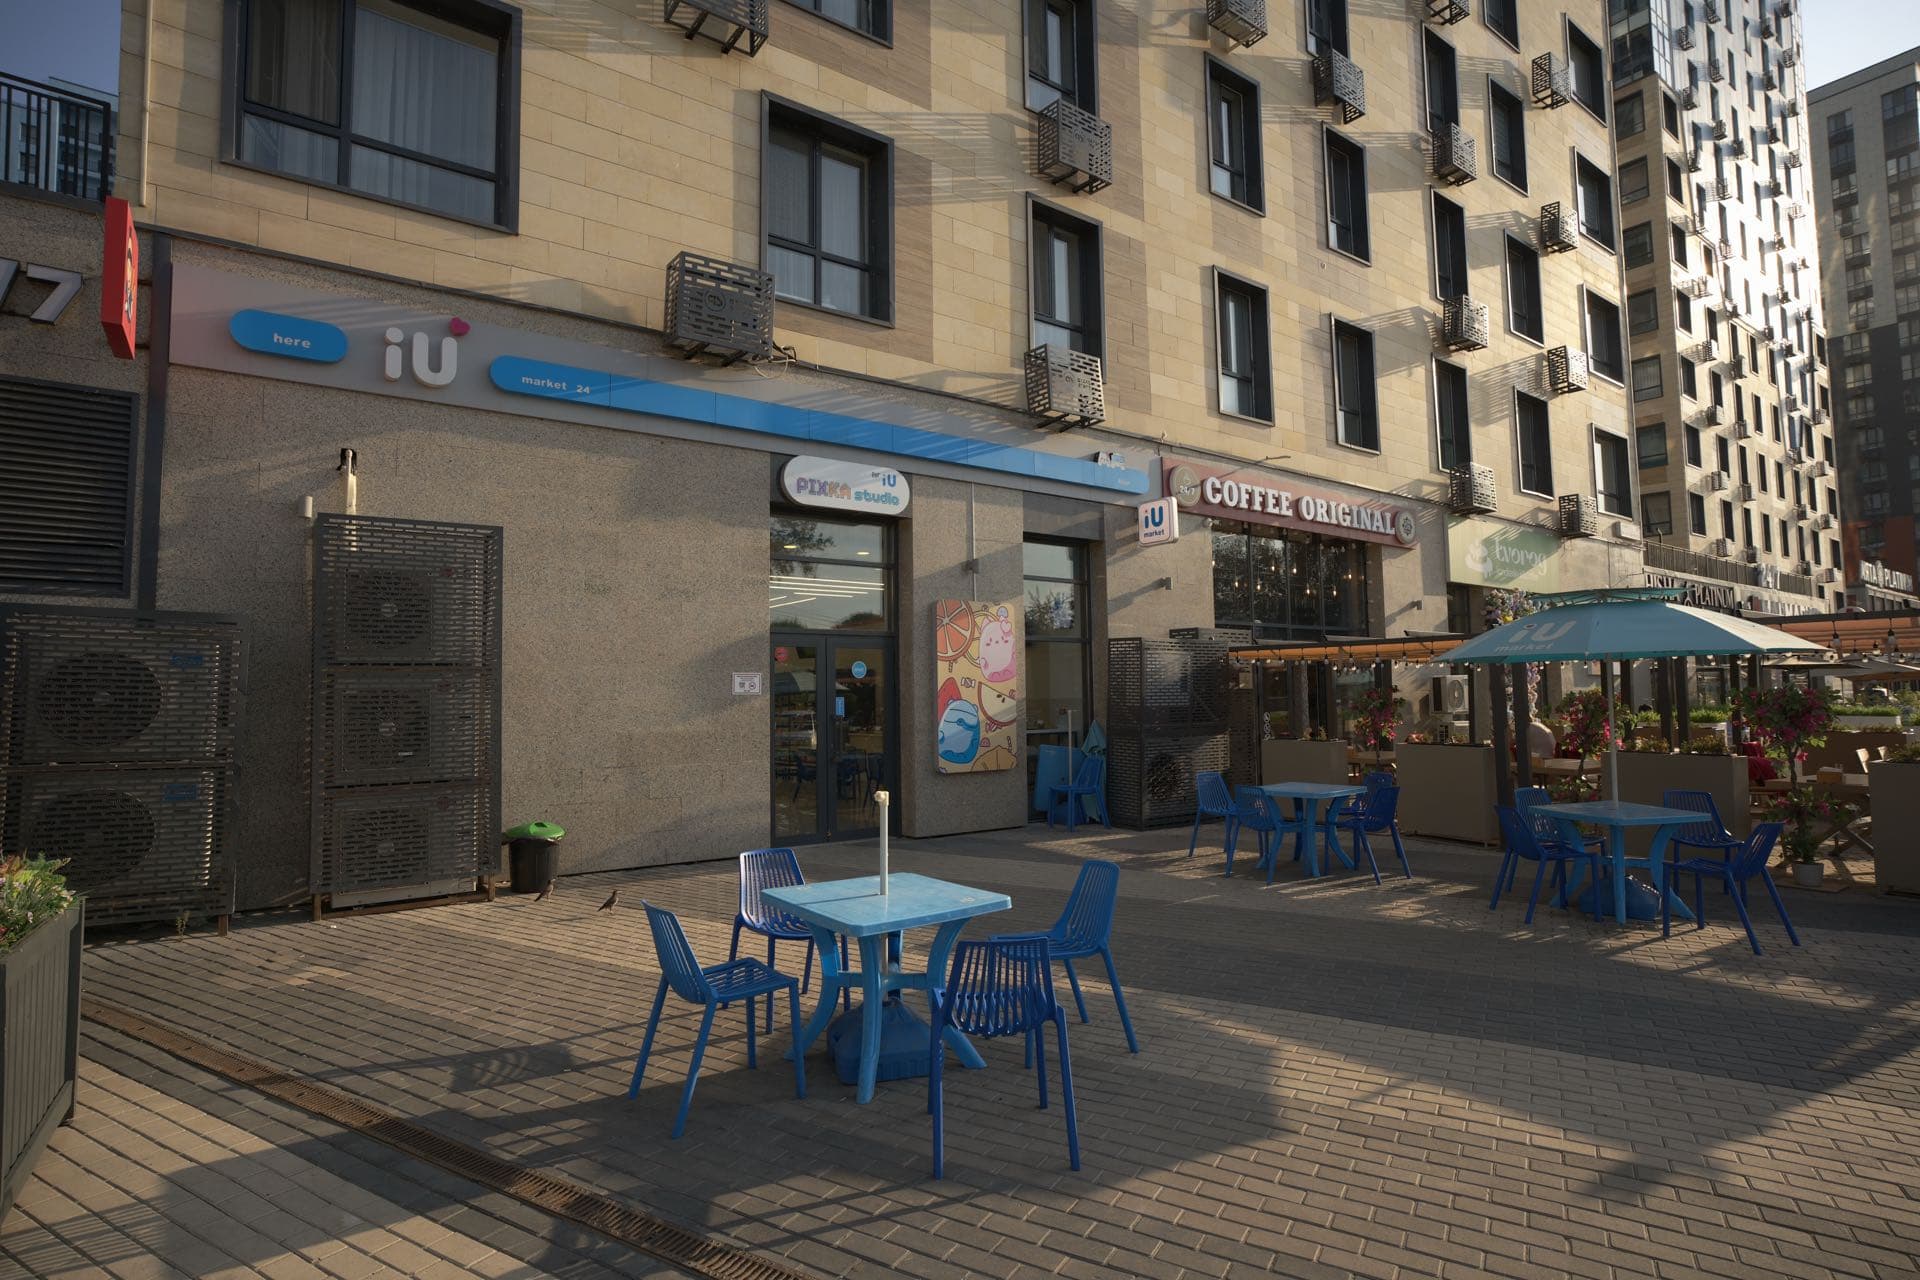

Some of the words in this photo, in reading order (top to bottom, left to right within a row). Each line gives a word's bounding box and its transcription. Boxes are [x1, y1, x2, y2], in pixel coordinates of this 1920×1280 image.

[273, 332, 311, 349] here
[521, 374, 568, 391] market
[576, 384, 591, 395] 24
[854, 489, 900, 507] studio
[1203, 476, 1293, 517] COFFEE
[1299, 495, 1396, 535] ORIGINAL
[1144, 506, 1164, 529] iU
[1143, 529, 1165, 539] market
[1694, 583, 1735, 610] PLATINUM
[1494, 642, 1554, 654] market
